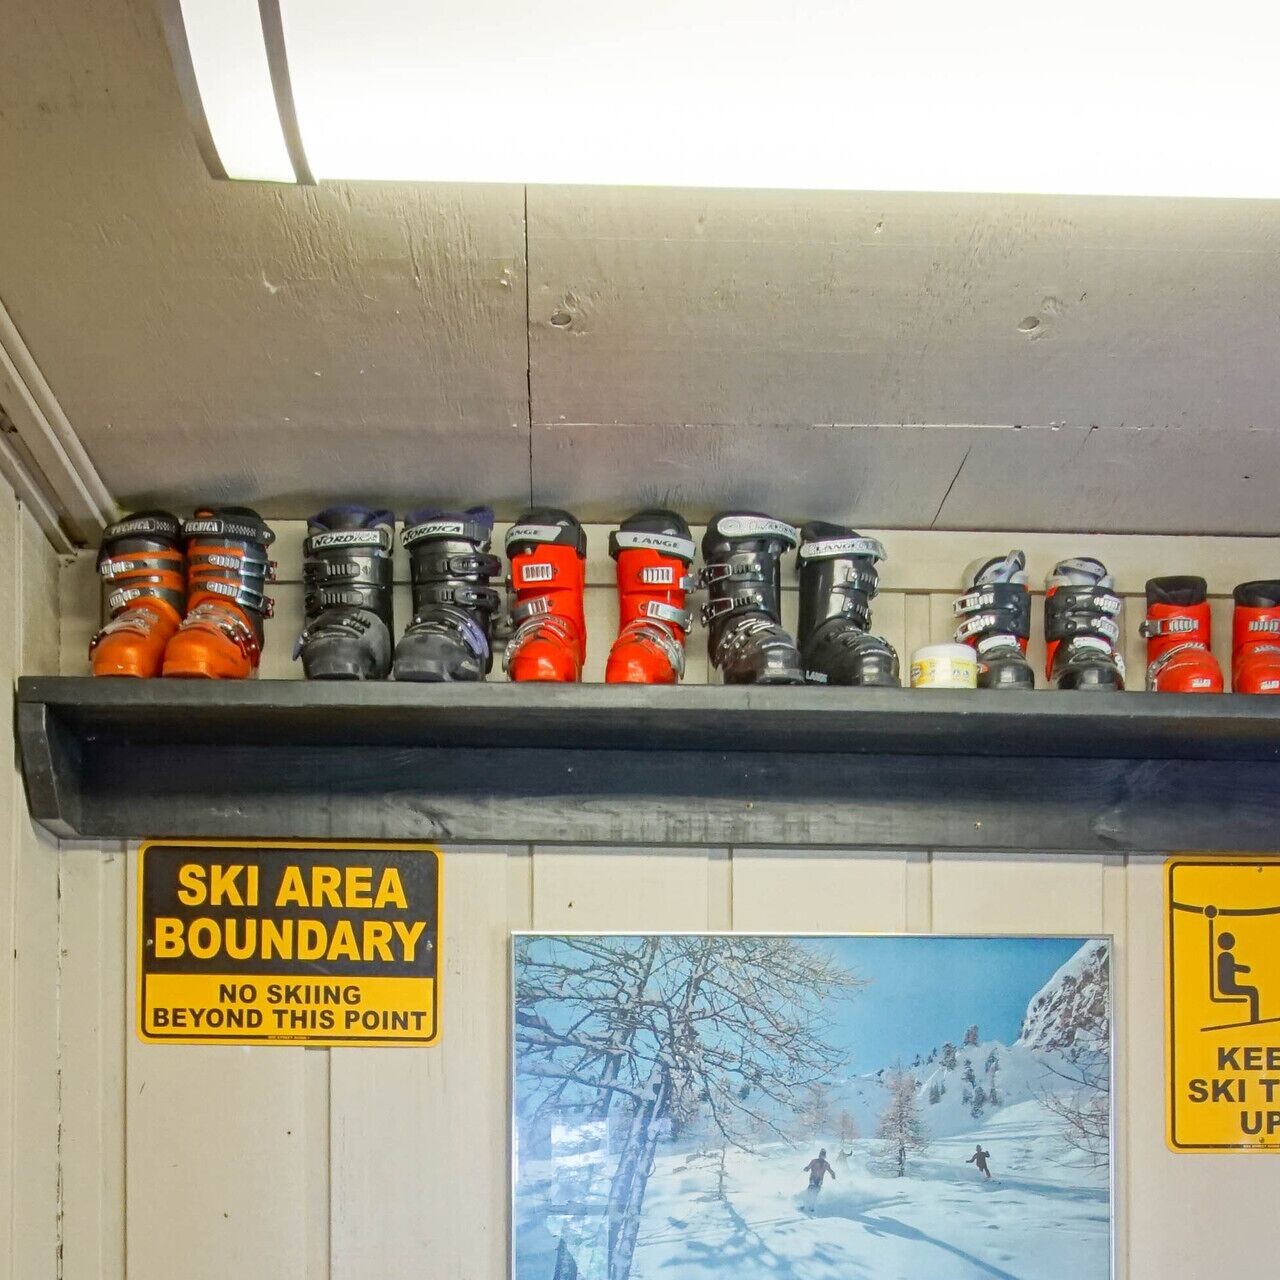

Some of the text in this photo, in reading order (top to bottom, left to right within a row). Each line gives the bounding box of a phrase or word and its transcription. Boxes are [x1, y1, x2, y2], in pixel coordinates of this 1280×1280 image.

[402, 525, 461, 544] NORDICA
[507, 530, 539, 539] ANGE
[632, 537, 680, 549] LANGE
[177, 863, 408, 909] SKI AREA
[154, 917, 427, 962] BOUNDARY
[219, 983, 361, 1005] NO SKIING
[153, 1007, 427, 1031] BEYOND THIS POINT
[1187, 1079, 1247, 1103] SKI
